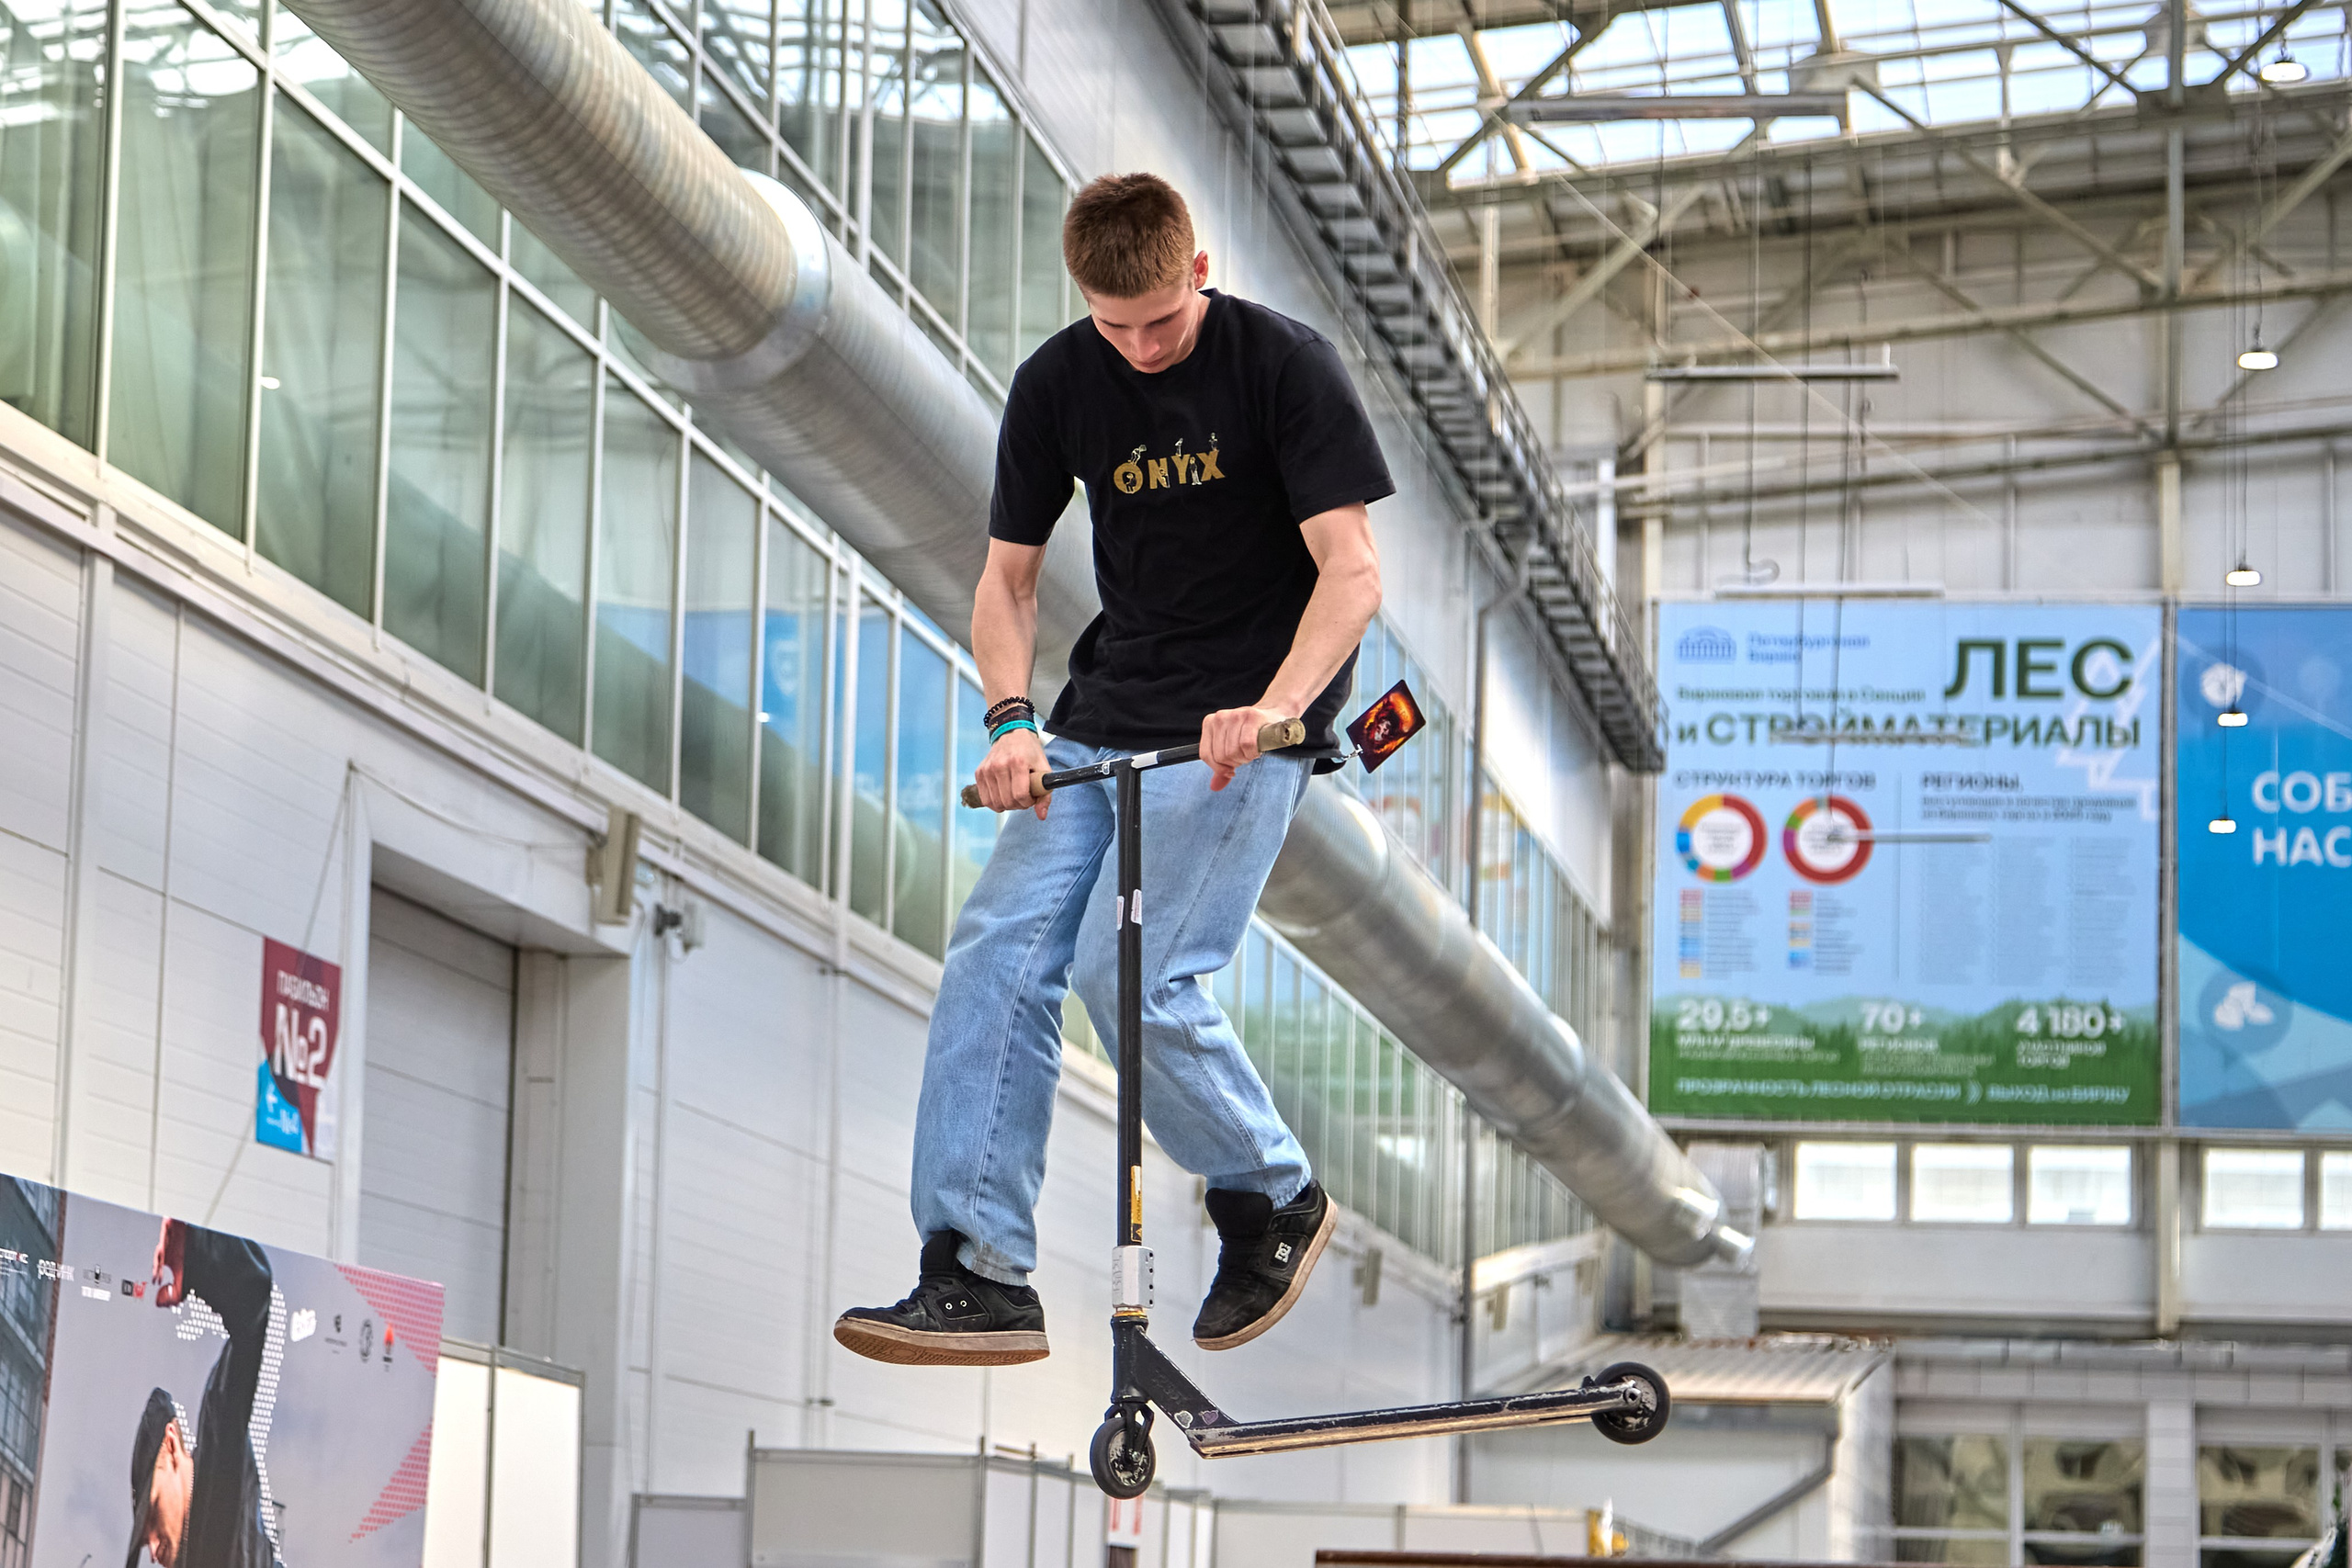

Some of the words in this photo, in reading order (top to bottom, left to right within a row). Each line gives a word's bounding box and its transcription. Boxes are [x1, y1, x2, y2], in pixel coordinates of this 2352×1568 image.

[1114, 450, 1226, 494] ONYX
[1944, 638, 2134, 700] ЛЕС
[1678, 722, 1697, 743] и
[1705, 709, 2141, 747] СТРОЙМАТЕРИАЛЫ
[2252, 771, 2352, 814] СОБ
[2252, 825, 2352, 868] НАС
[275, 1002, 327, 1090] №2
[1274, 1242, 1292, 1263] DC
